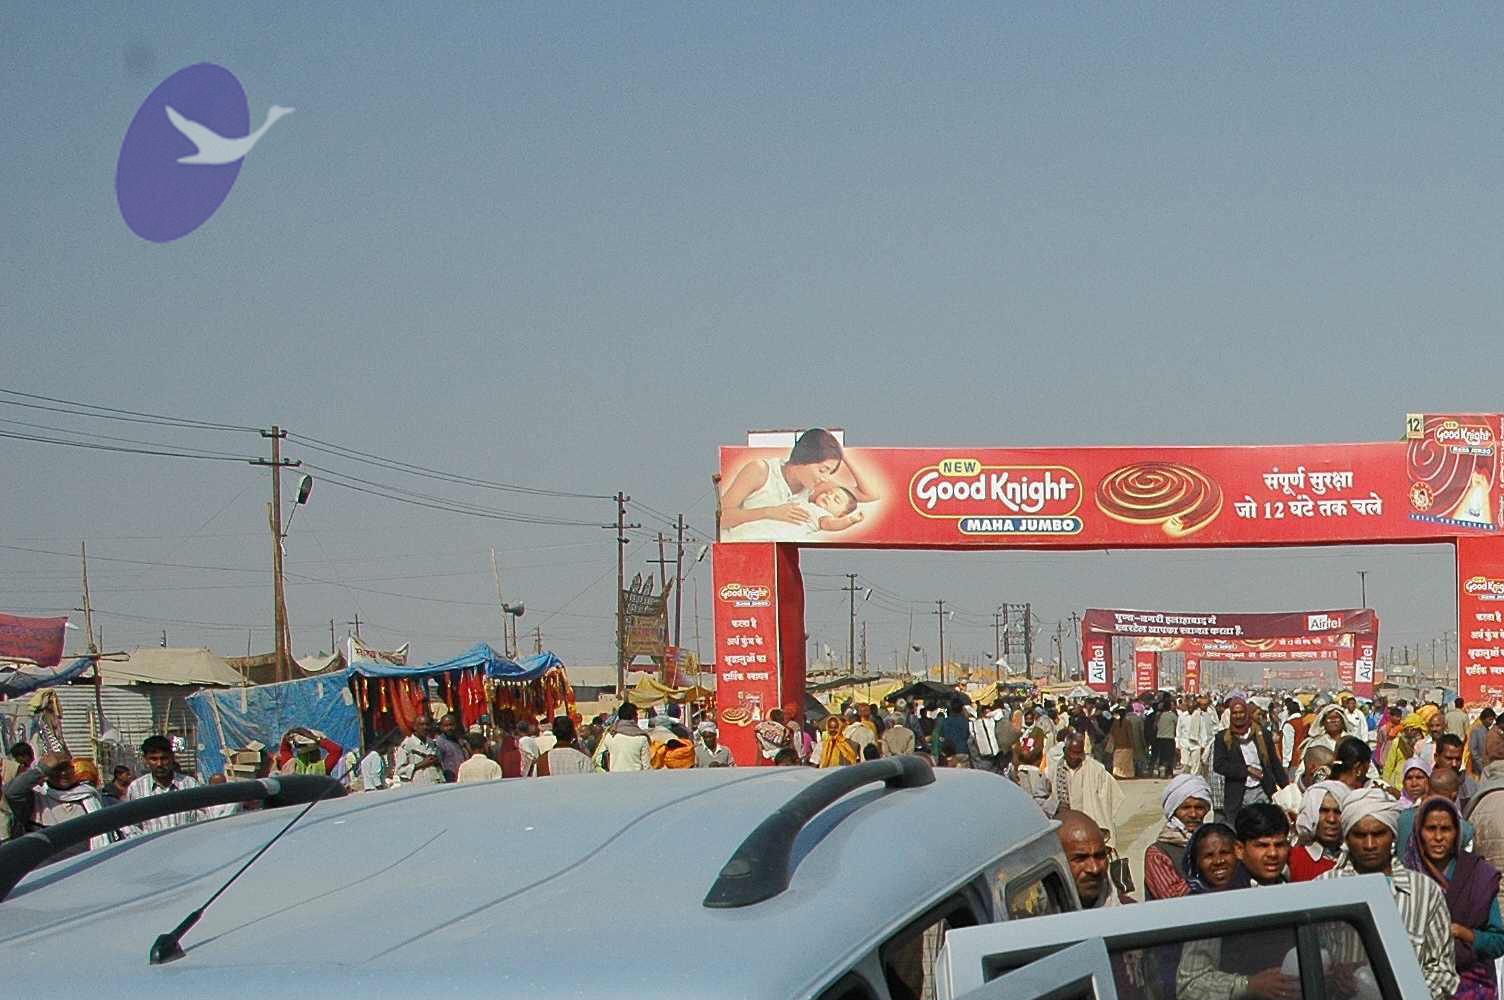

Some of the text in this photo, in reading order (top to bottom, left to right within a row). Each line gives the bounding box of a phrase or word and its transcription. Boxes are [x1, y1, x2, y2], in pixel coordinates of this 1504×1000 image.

[1408, 418, 1420, 433] 12
[1437, 426, 1491, 445] Good Knight
[943, 461, 977, 473] NEW
[1262, 466, 1353, 496] संपूर्ण सुरक्षा
[916, 472, 1075, 513] Good Knight
[1233, 496, 1257, 518] जो
[1263, 501, 1286, 519] 12
[1287, 494, 1314, 517] घंटे
[1316, 499, 1348, 517] तक
[967, 519, 1075, 532] MAHA JUMBO
[1465, 581, 1488, 592] Good
[1311, 617, 1342, 630] Airtel
[1092, 645, 1105, 681] Airtel
[1360, 645, 1373, 681] Airtel
